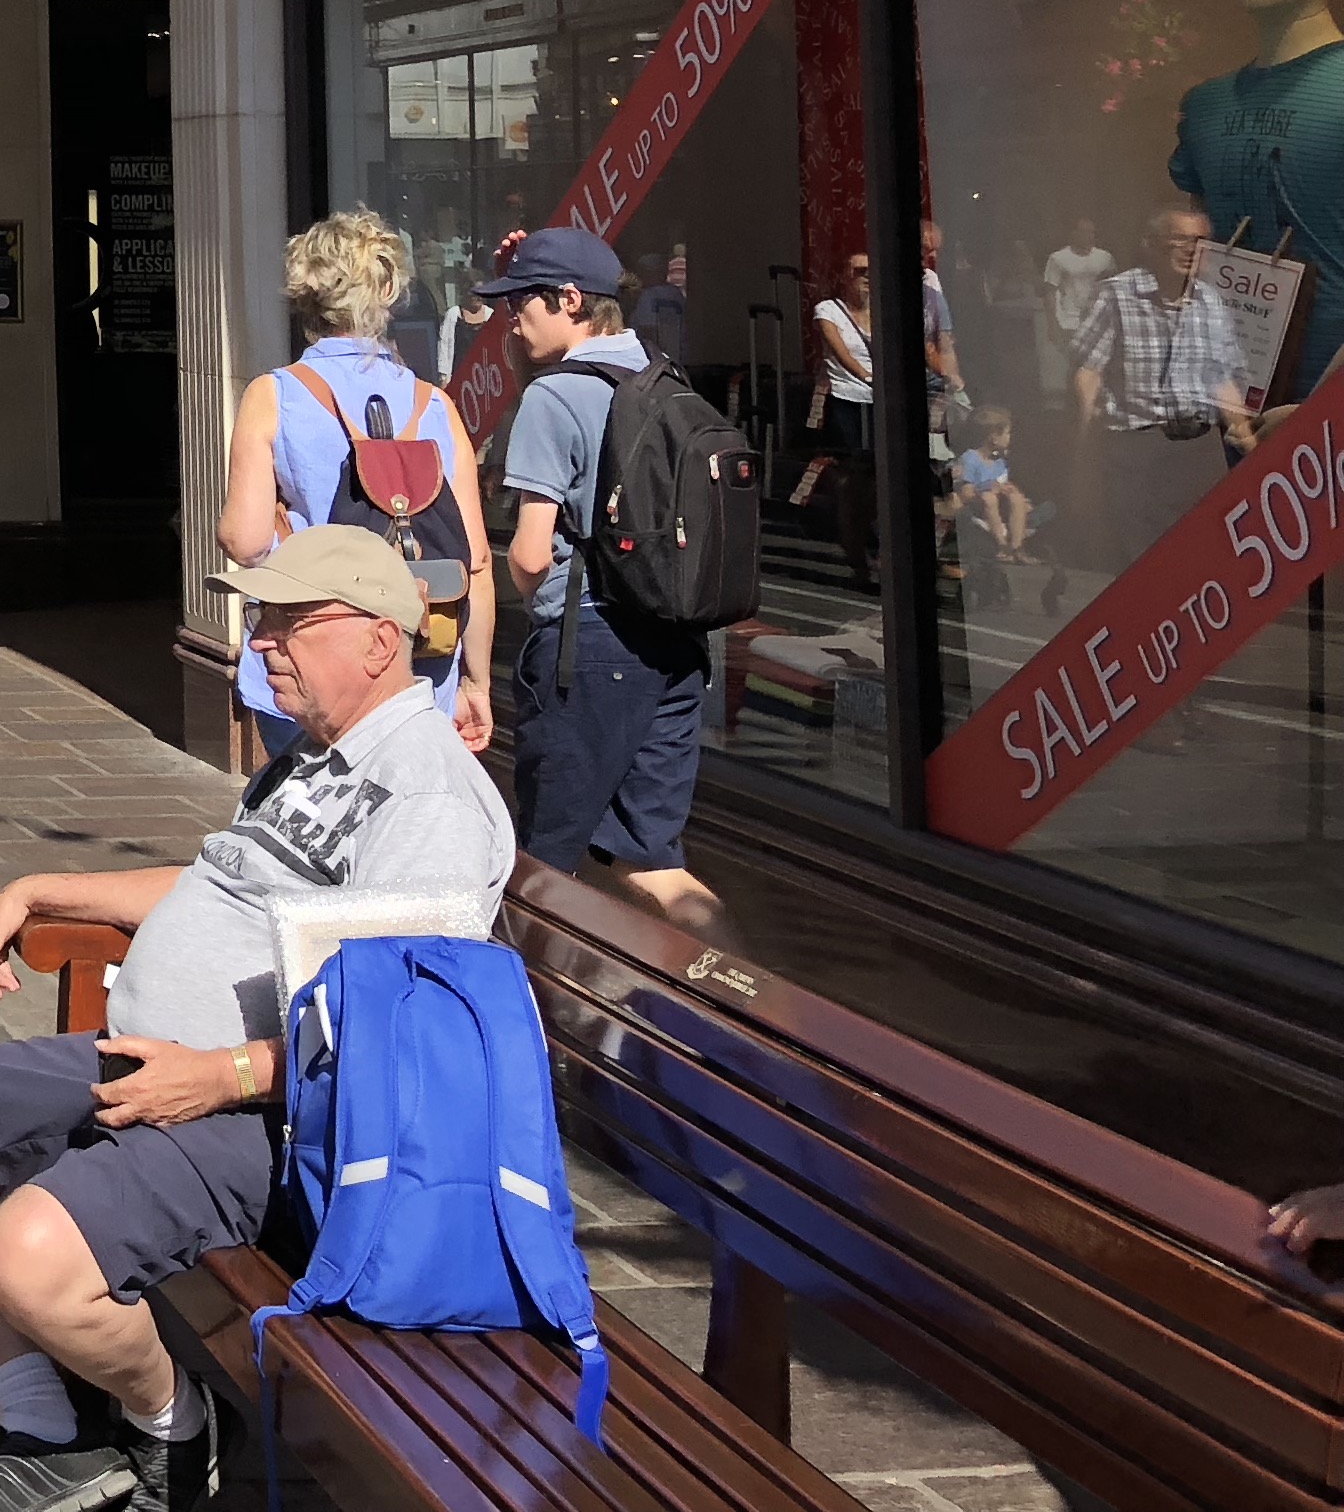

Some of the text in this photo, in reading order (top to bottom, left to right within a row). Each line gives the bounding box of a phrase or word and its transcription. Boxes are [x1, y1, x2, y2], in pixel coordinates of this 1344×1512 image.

[110, 162, 170, 179] MAKEUP
[569, 147, 629, 239] ALE
[627, 133, 650, 180] UP
[651, 91, 679, 142] TO
[111, 193, 173, 212] COMPLI
[112, 238, 175, 256] APPLICA
[113, 256, 173, 273] & LESSO
[1215, 265, 1278, 301] Sale
[461, 346, 504, 436] 0%
[1001, 418, 1344, 801] SALE UP TO 50%
